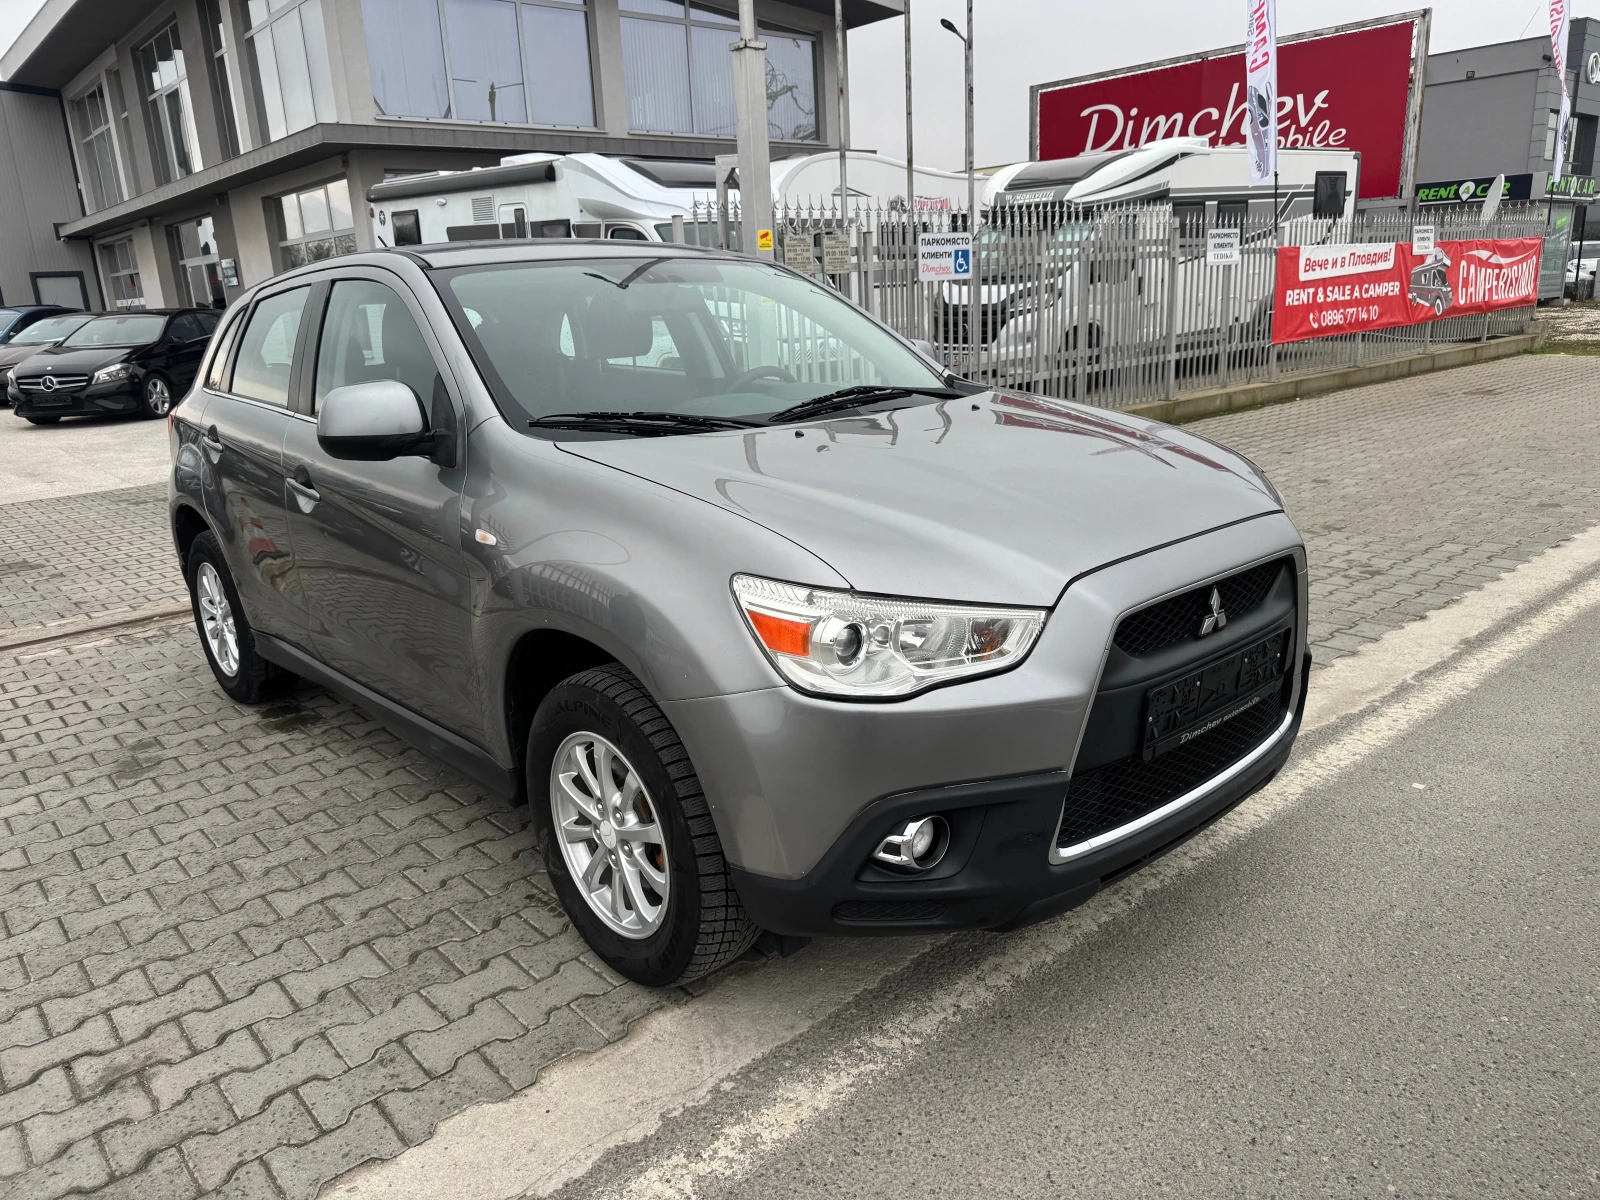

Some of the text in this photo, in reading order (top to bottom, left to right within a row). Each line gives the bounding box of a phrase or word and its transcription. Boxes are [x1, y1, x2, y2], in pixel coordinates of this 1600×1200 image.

[1080, 82, 1330, 153] Dimchev
[1461, 185, 1471, 196] A
[1476, 182, 1511, 197] CR
[1577, 178, 1595, 194] CAR
[921, 237, 970, 246] ПАРКОМЯСТО
[921, 251, 953, 260] КЛИЕНТИ
[1303, 248, 1392, 273] Вече и в Пловдив!
[921, 263, 951, 273] Dimchev
[1458, 254, 1537, 305] CAMPERISIMO
[1285, 282, 1400, 306] RENT & SALE A CAMPER
[1320, 305, 1379, 327] 0896 77 14 10
[1180, 717, 1222, 744] Dimchev
